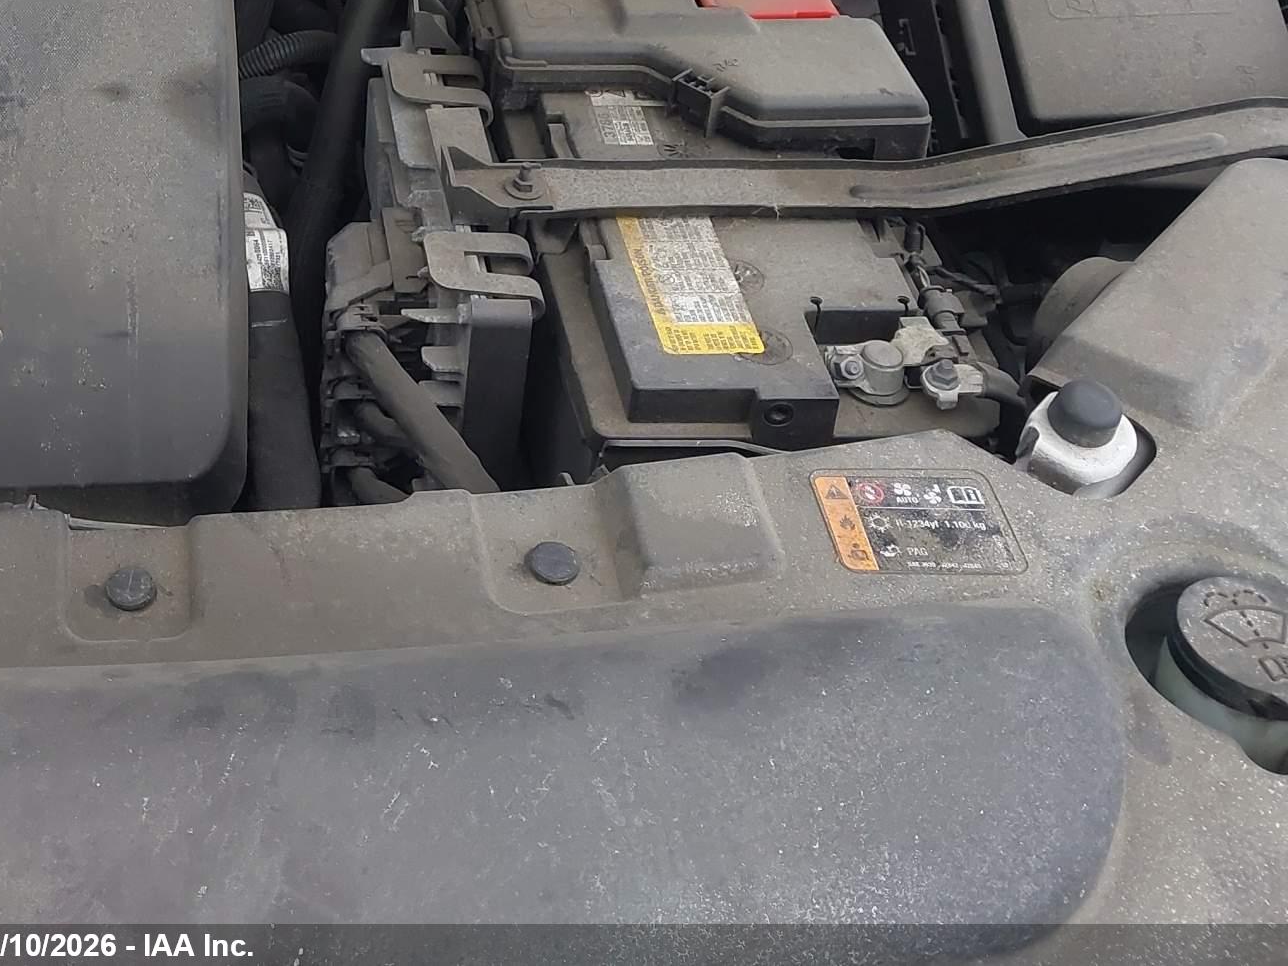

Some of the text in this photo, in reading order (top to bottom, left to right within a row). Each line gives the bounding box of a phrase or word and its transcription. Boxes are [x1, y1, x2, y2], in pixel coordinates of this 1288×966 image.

[896, 496, 919, 504] AUTO
[973, 520, 987, 531] kg
[906, 546, 928, 556] PAG
